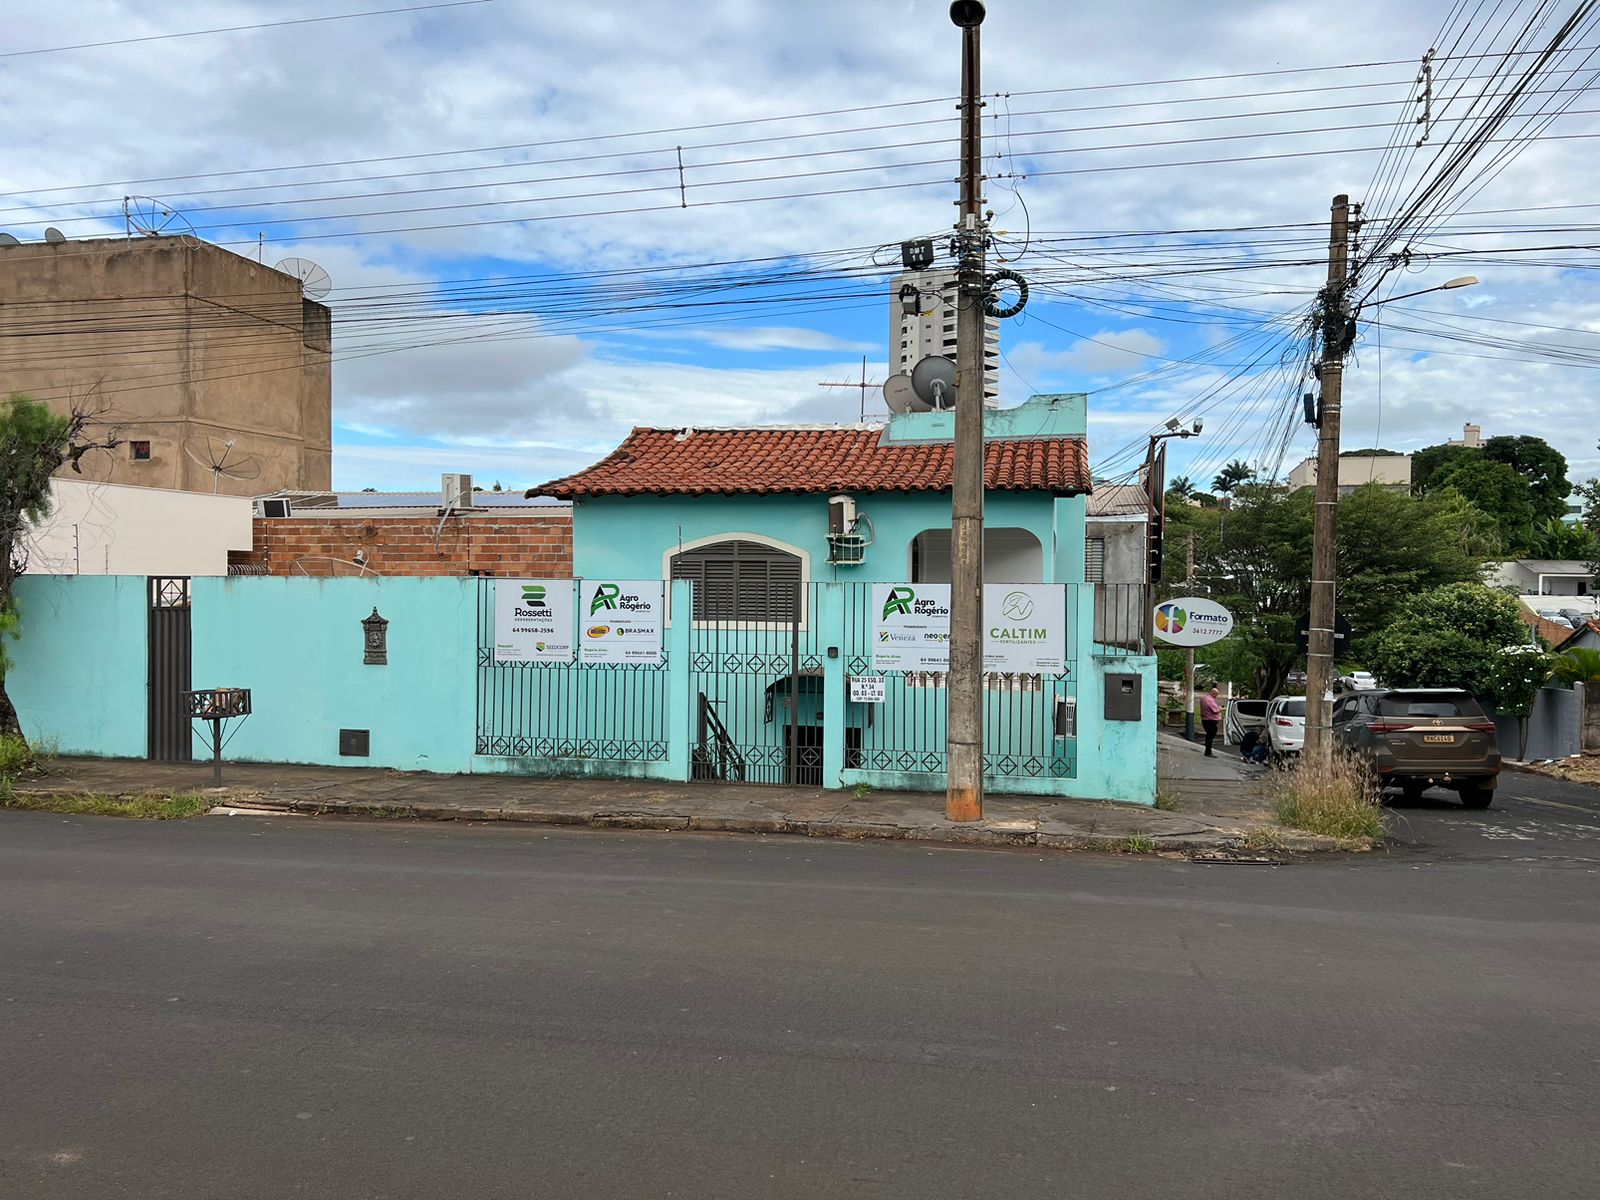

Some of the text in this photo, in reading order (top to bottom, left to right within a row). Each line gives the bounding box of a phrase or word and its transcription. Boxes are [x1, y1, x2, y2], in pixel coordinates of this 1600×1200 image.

[619, 594, 639, 603] Agro
[914, 598, 936, 608] Agro
[619, 602, 651, 612] Rogério
[914, 606, 949, 616] Rogério
[514, 607, 553, 618] Rossetti
[1189, 611, 1228, 623] Formato
[990, 628, 1047, 639] CALTIM
